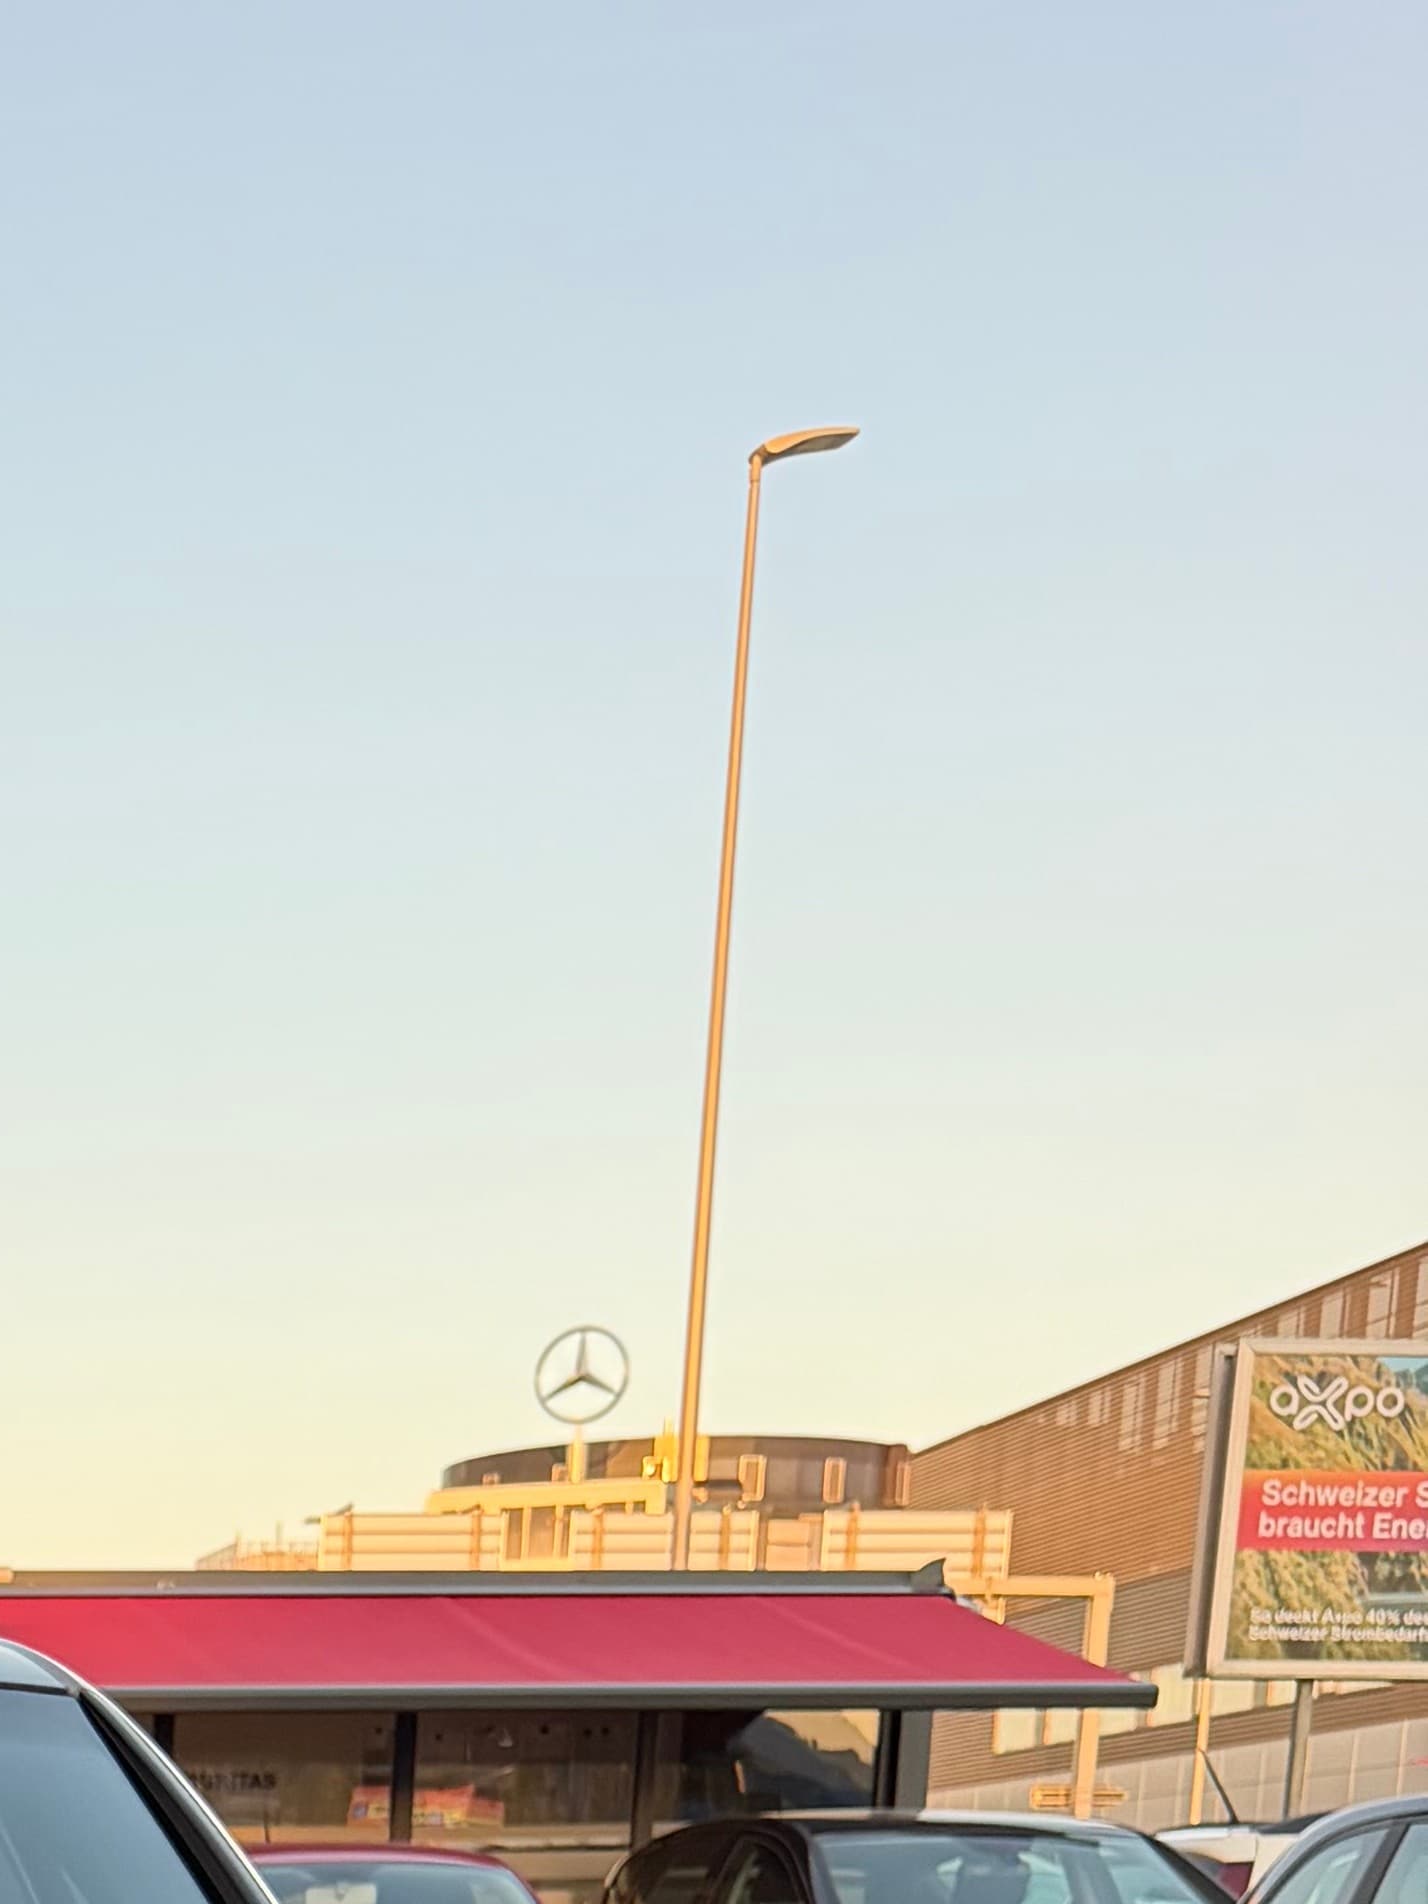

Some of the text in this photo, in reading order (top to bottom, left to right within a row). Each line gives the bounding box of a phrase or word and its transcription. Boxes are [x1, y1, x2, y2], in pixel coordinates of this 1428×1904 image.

[1270, 1375, 1405, 1431] axpo
[1261, 1479, 1407, 1508] Schweizer
[1258, 1512, 1428, 1541] braucht Ene
[1365, 1607, 1400, 1626] 40%
[1248, 1623, 1328, 1641] Schweizer
